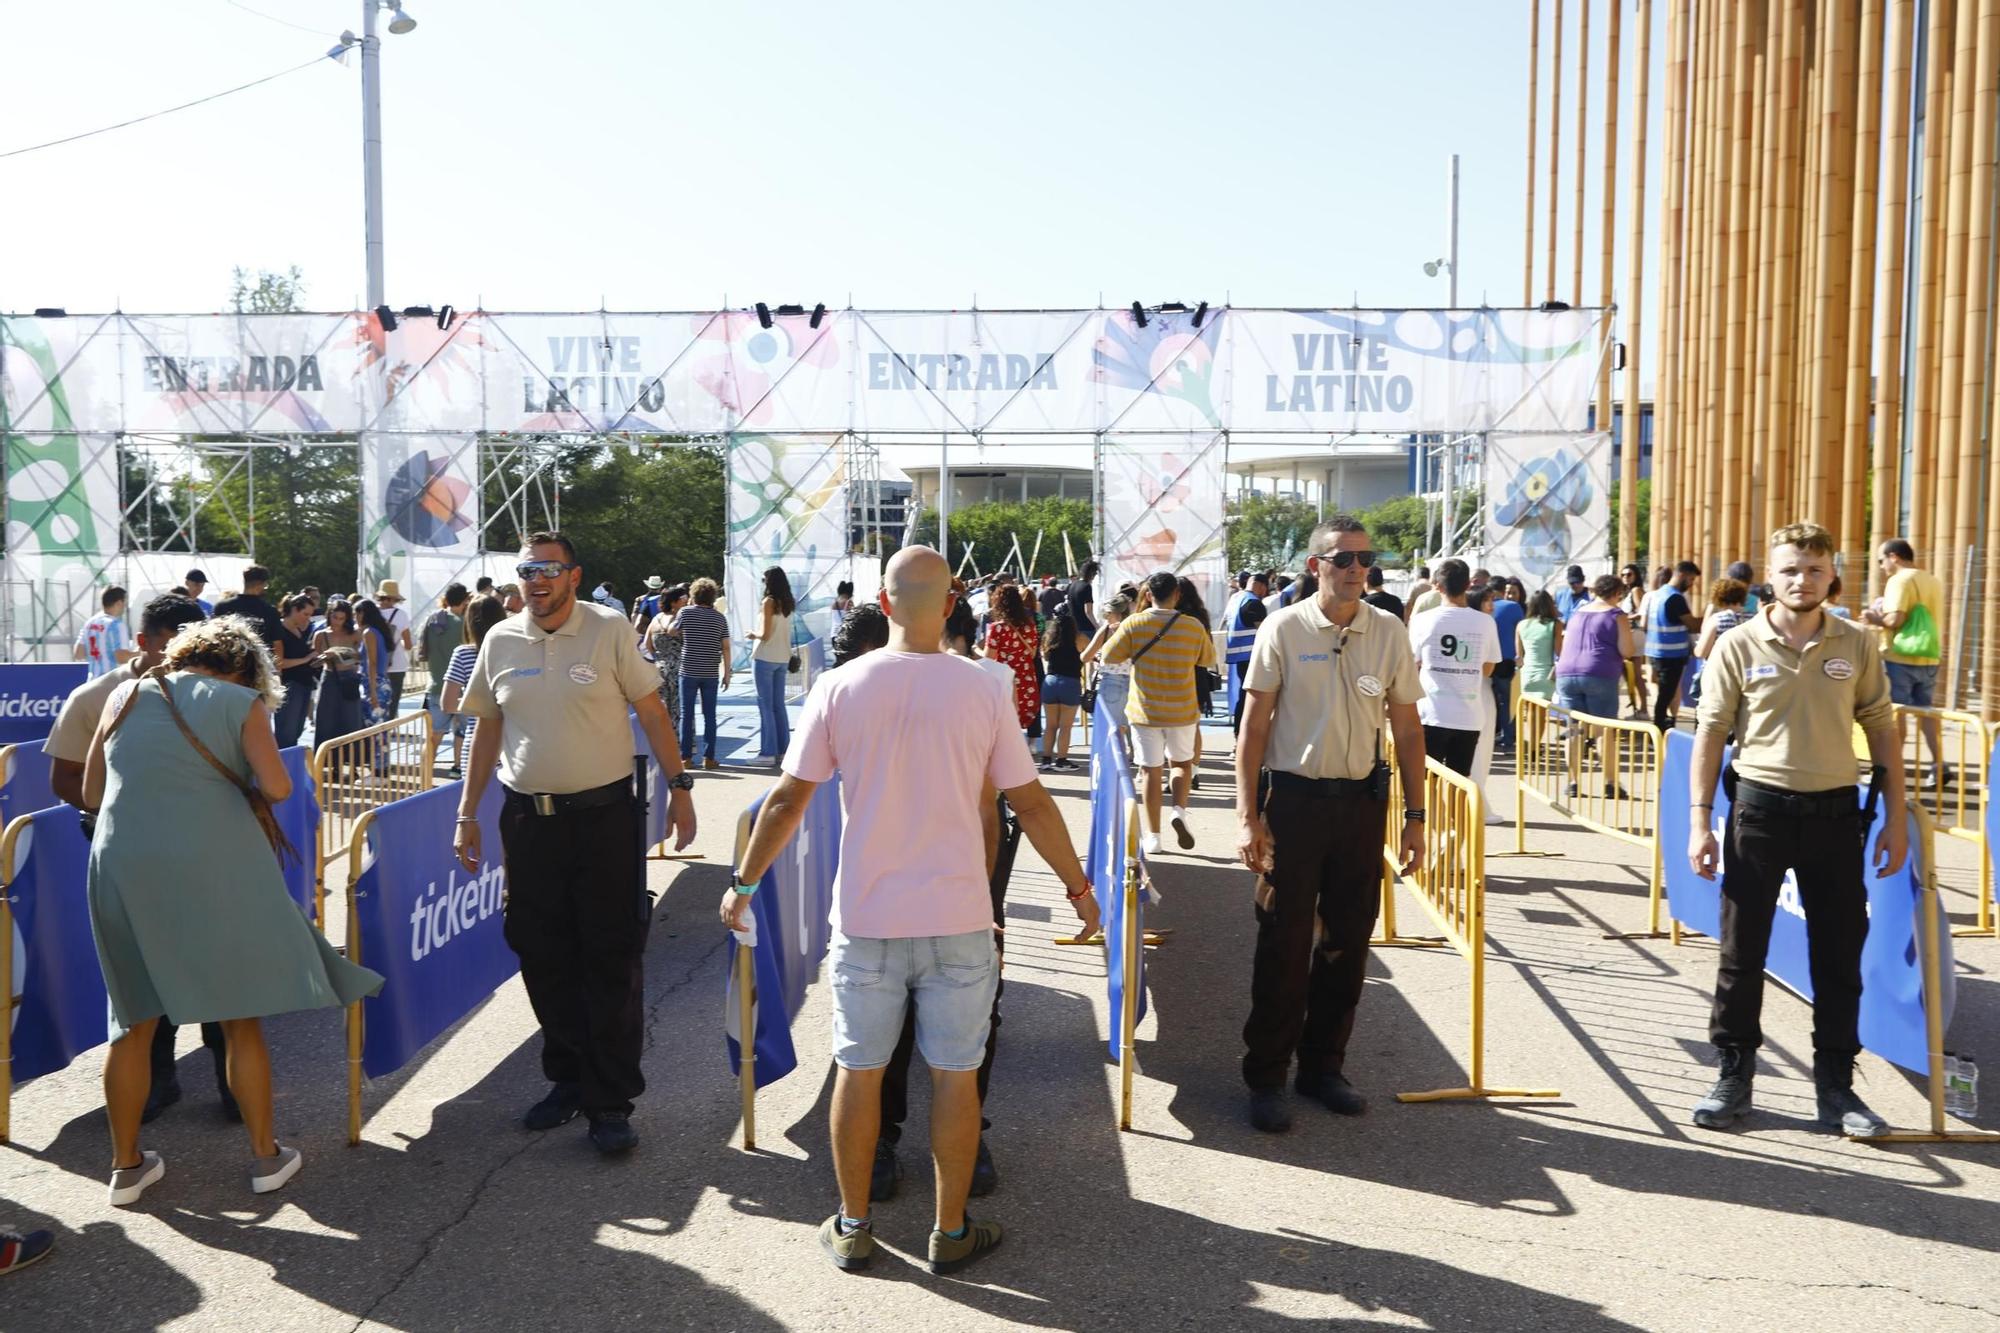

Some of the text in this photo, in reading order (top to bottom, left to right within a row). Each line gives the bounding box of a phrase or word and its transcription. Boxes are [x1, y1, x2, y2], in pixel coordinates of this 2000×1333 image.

[547, 336, 641, 373] VIVE
[1291, 333, 1389, 371] VIVE
[143, 355, 324, 392] ENTRADA
[868, 353, 1059, 391] ENTRADA
[523, 376, 665, 413] LATINO
[1265, 374, 1413, 413] LATINO
[0, 692, 66, 717] icket
